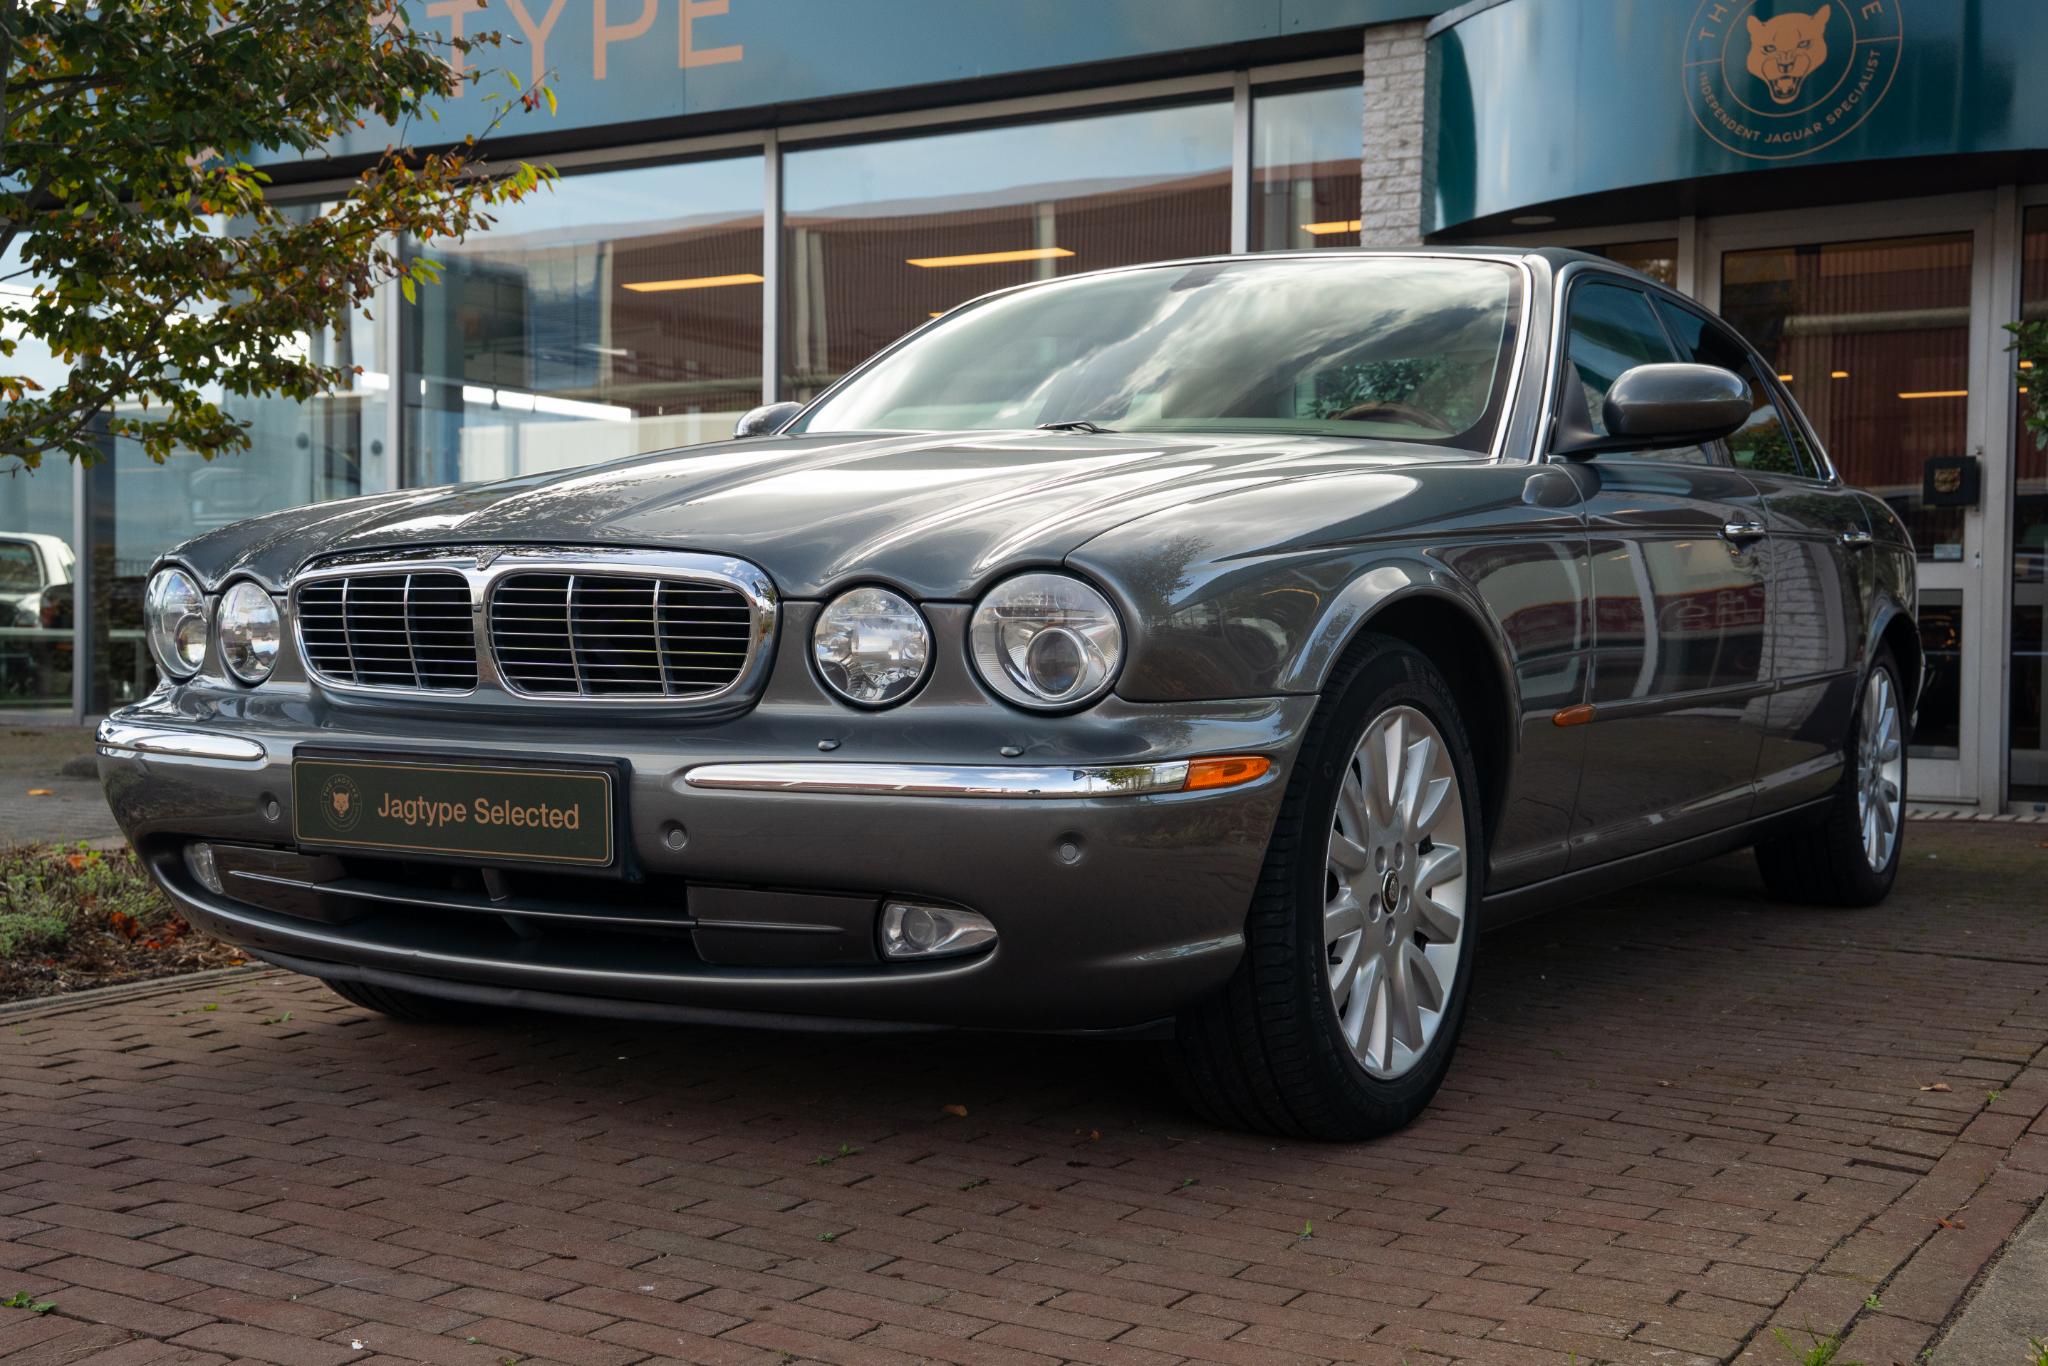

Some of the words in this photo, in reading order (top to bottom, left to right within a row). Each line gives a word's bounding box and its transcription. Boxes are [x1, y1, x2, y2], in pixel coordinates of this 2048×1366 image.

[367, 0, 743, 98] TYPE
[1699, 0, 1736, 40] TH
[1699, 72, 1761, 142] INDEPENDENT
[1764, 121, 1824, 144] JAGUAR
[1825, 49, 1881, 126] SPECIALIST
[377, 792, 467, 827] Jagtype
[474, 797, 579, 830] Selected
